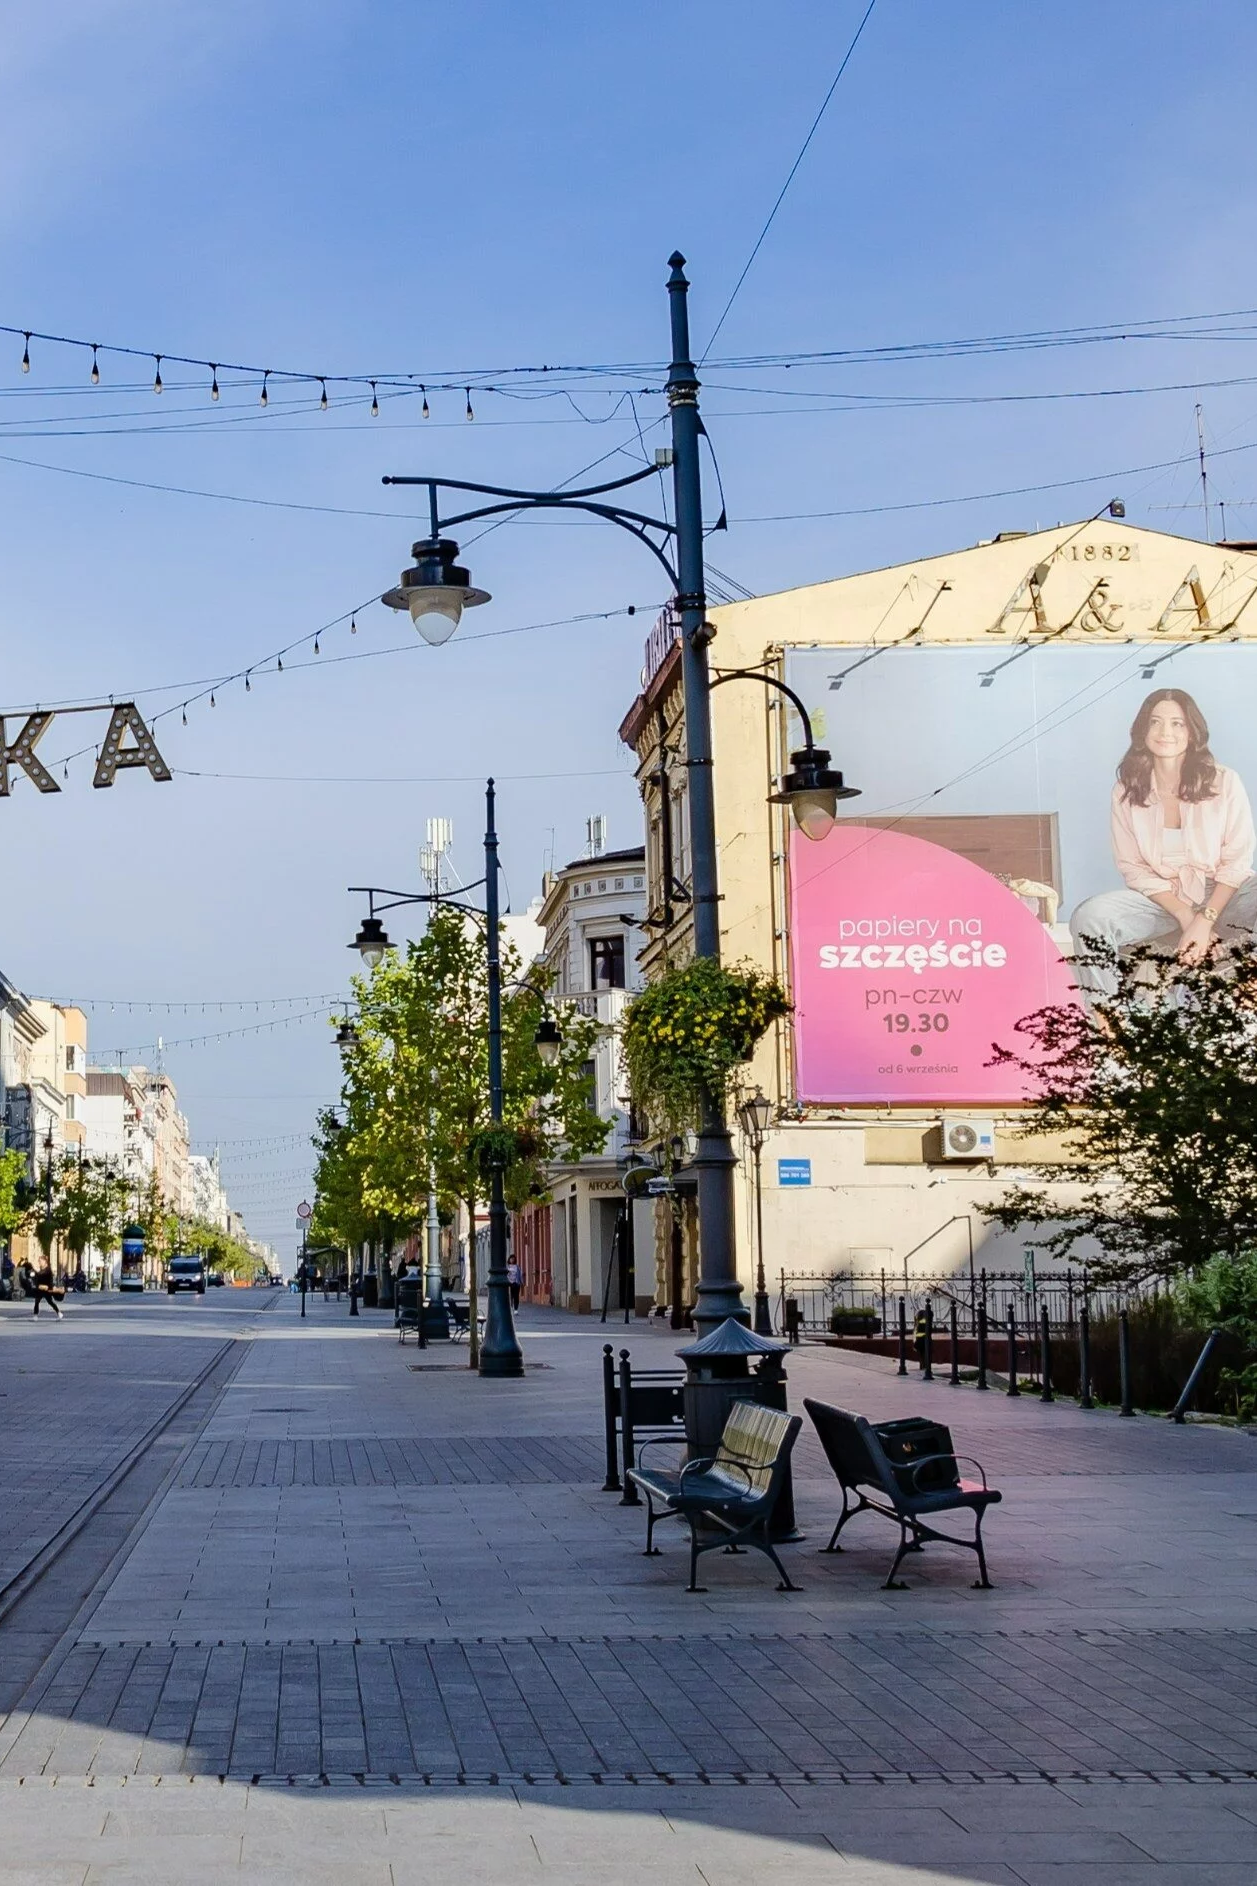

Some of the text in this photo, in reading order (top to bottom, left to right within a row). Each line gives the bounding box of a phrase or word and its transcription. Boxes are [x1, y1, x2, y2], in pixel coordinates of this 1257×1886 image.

[1069, 545, 1131, 562] 1882
[985, 563, 1224, 633] A & A
[839, 916, 982, 940] papiery na
[819, 940, 1007, 975] szczęście
[865, 988, 963, 1010] pn-czw
[883, 1013, 950, 1033] 19.30
[878, 1062, 959, 1074] od 6 września
